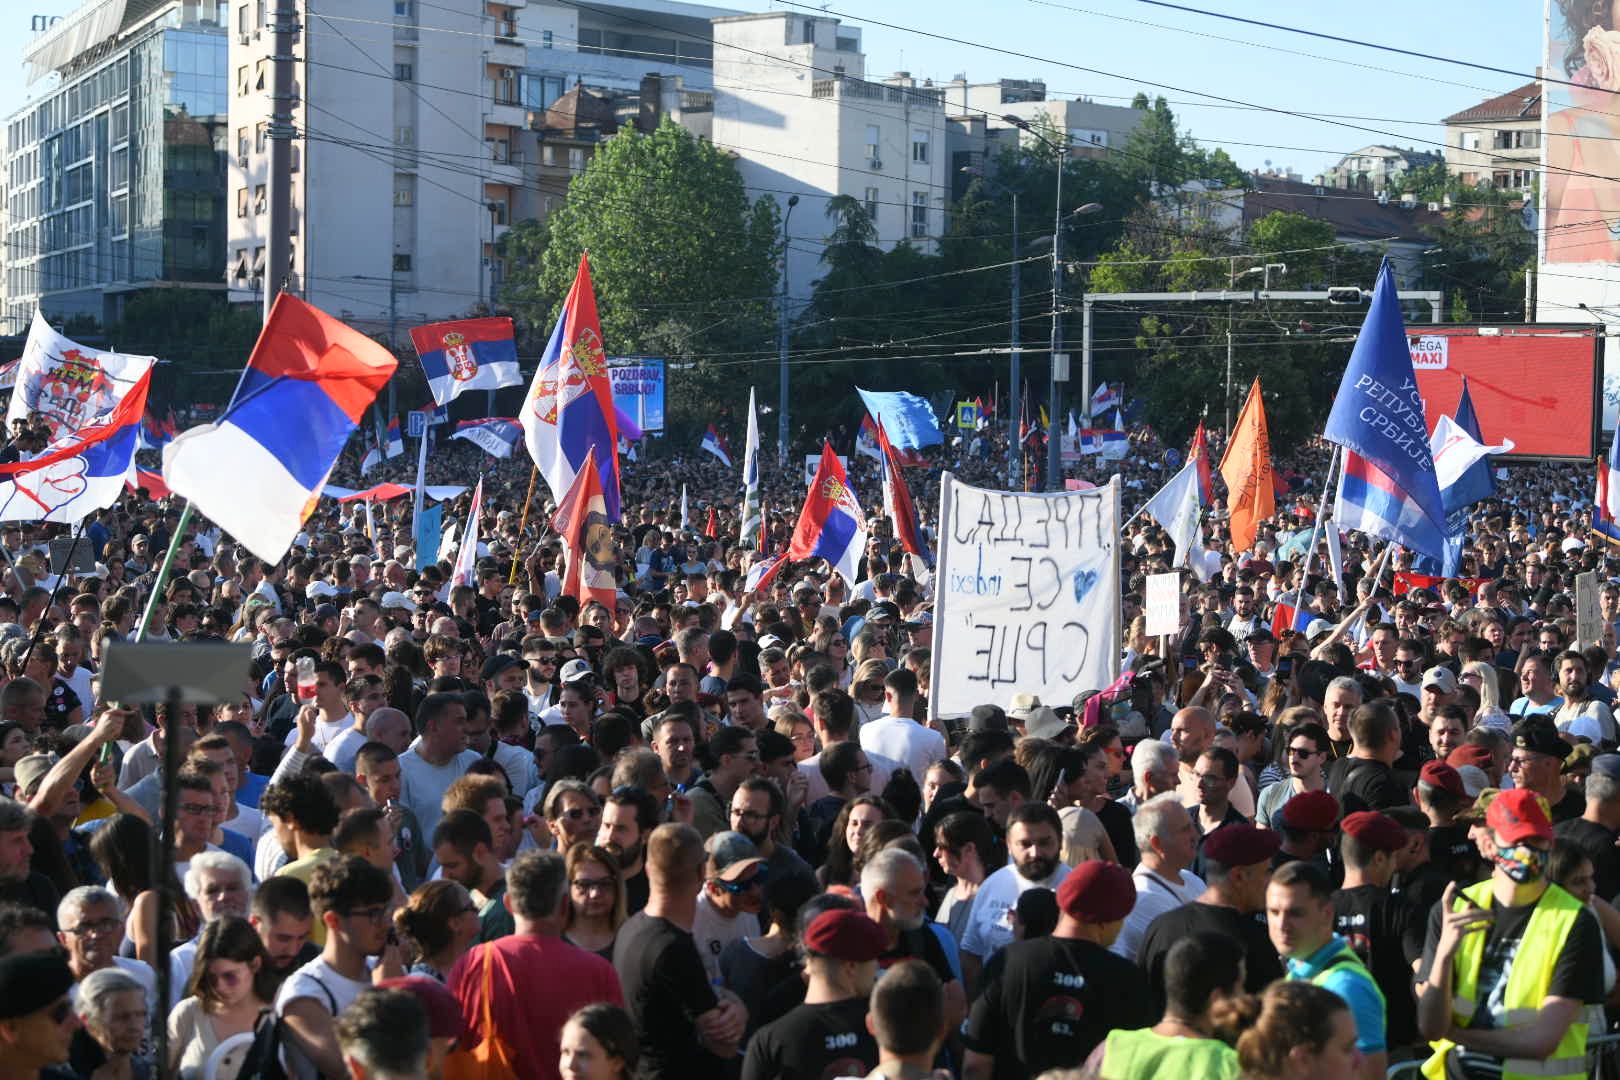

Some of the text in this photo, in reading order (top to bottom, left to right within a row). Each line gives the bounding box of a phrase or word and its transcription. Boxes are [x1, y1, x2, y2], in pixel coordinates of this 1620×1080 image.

[1411, 341, 1442, 351] MEGA
[1411, 352, 1442, 364] MAXI
[612, 368, 661, 384] POZDRAV,
[1359, 406, 1432, 471] СРБИЈЕ
[1053, 972, 1085, 988] 300
[824, 1032, 858, 1049] 300
